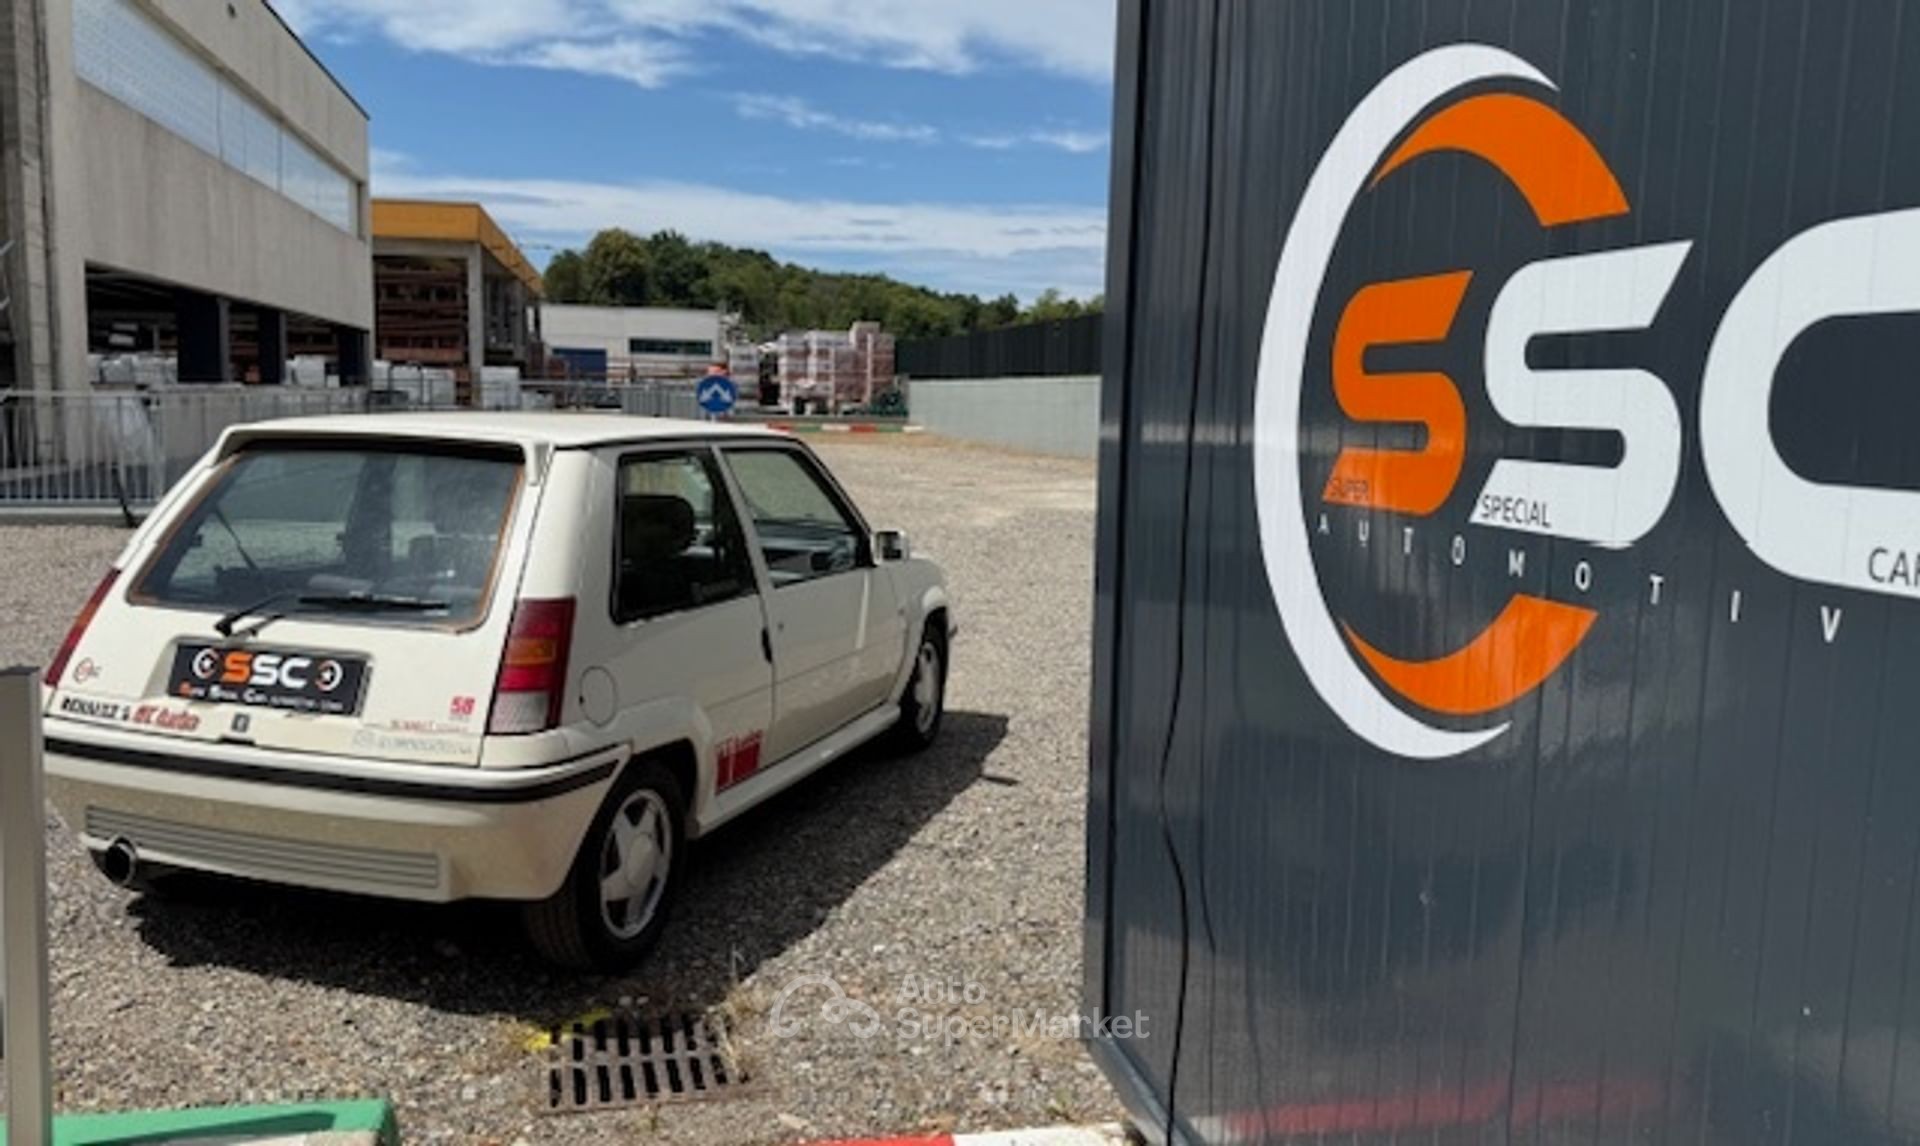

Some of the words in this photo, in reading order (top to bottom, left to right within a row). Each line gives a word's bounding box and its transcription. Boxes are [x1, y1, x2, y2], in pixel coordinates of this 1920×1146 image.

[1330, 479, 1370, 501] SUPER
[1480, 494, 1552, 529] SPECIAL
[221, 651, 311, 689] SSC
